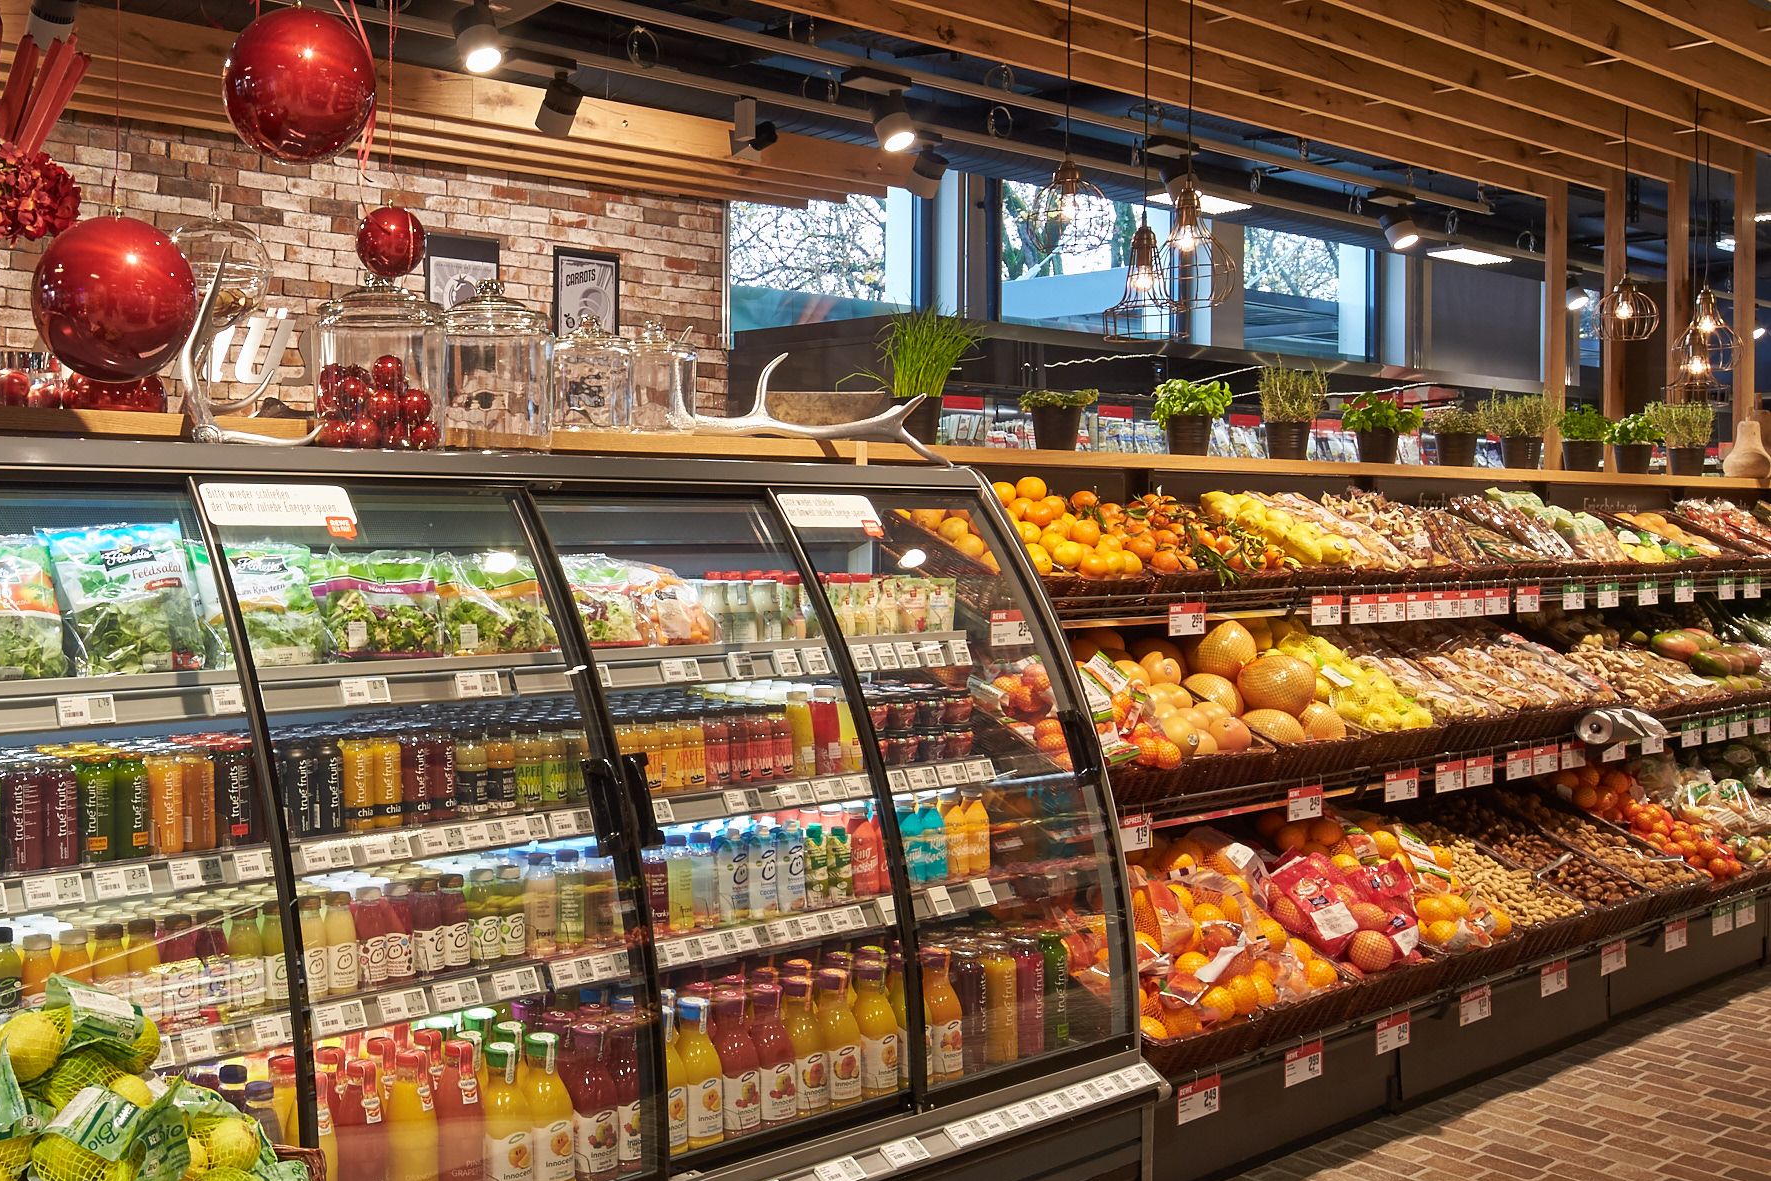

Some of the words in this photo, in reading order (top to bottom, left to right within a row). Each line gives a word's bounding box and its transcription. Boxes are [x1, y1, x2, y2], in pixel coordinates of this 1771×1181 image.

[565, 269, 596, 287] CARROTS
[205, 487, 225, 499] Bitte
[228, 488, 253, 499] wieder
[257, 488, 290, 499] schließen
[211, 502, 223, 512] der
[226, 502, 253, 513] Umwelt
[257, 503, 281, 513] zuliebe
[284, 501, 311, 516] Energie
[104, 549, 154, 566] Florette
[328, 757, 337, 785] fruits
[355, 753, 365, 781] fruits
[383, 750, 392, 778] fruits
[416, 748, 424, 776] fruits
[444, 745, 453, 773] fruits
[228, 765, 238, 794] fruits
[297, 759, 307, 787] fruits
[58, 781, 67, 813] fruits
[85, 779, 96, 810] fruits
[132, 775, 142, 805] fruits
[164, 771, 173, 801] fruits
[329, 785, 339, 808] true
[356, 780, 365, 803] true
[384, 777, 393, 800] true
[417, 775, 425, 797] true
[12, 784, 23, 816] fruits
[229, 794, 239, 818] true
[299, 787, 308, 811] true
[386, 805, 401, 814] chia
[417, 802, 431, 811] chia
[86, 810, 96, 833] true
[133, 805, 142, 828] true
[165, 801, 174, 825] true
[358, 808, 373, 817] chia
[14, 817, 23, 842] true
[58, 813, 67, 837] true
[1135, 825, 1147, 843] 1.19
[63, 878, 78, 888] 2.39
[1034, 960, 1044, 993] fruits
[1055, 955, 1065, 989] fruits
[1003, 968, 1012, 1002] fruits
[1034, 992, 1044, 1018] true
[1057, 988, 1066, 1013] true
[1004, 1002, 1013, 1026] true
[1204, 1088, 1217, 1107] 2.49
